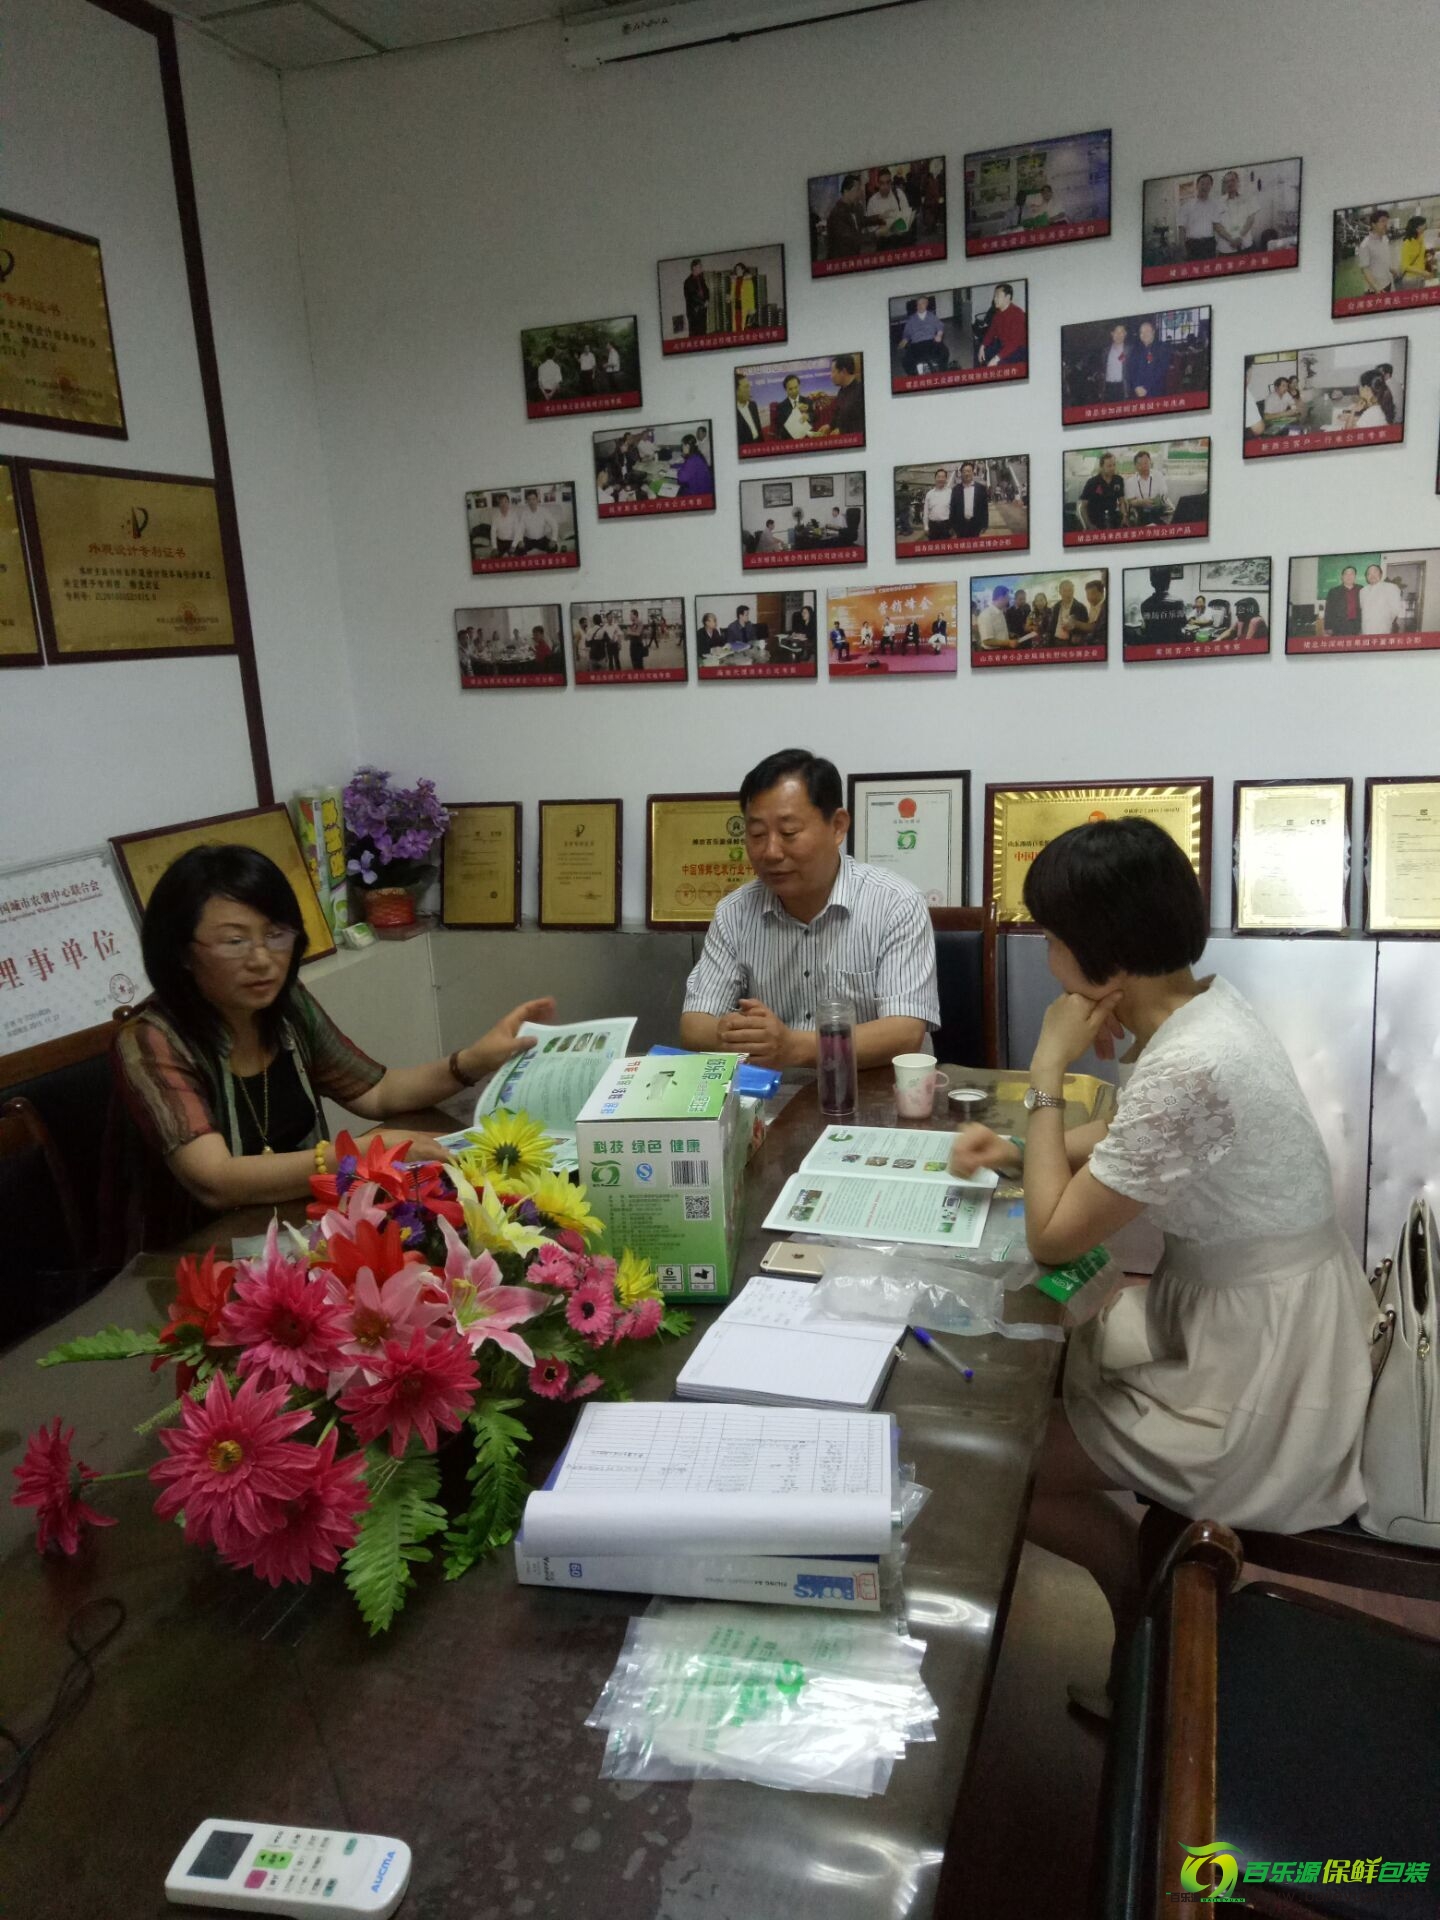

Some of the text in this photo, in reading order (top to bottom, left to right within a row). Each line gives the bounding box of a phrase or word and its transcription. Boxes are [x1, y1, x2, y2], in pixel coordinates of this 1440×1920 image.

[593, 1138, 701, 1154] 科技 绿色 健康
[370, 1850, 396, 1893] AUCMA
